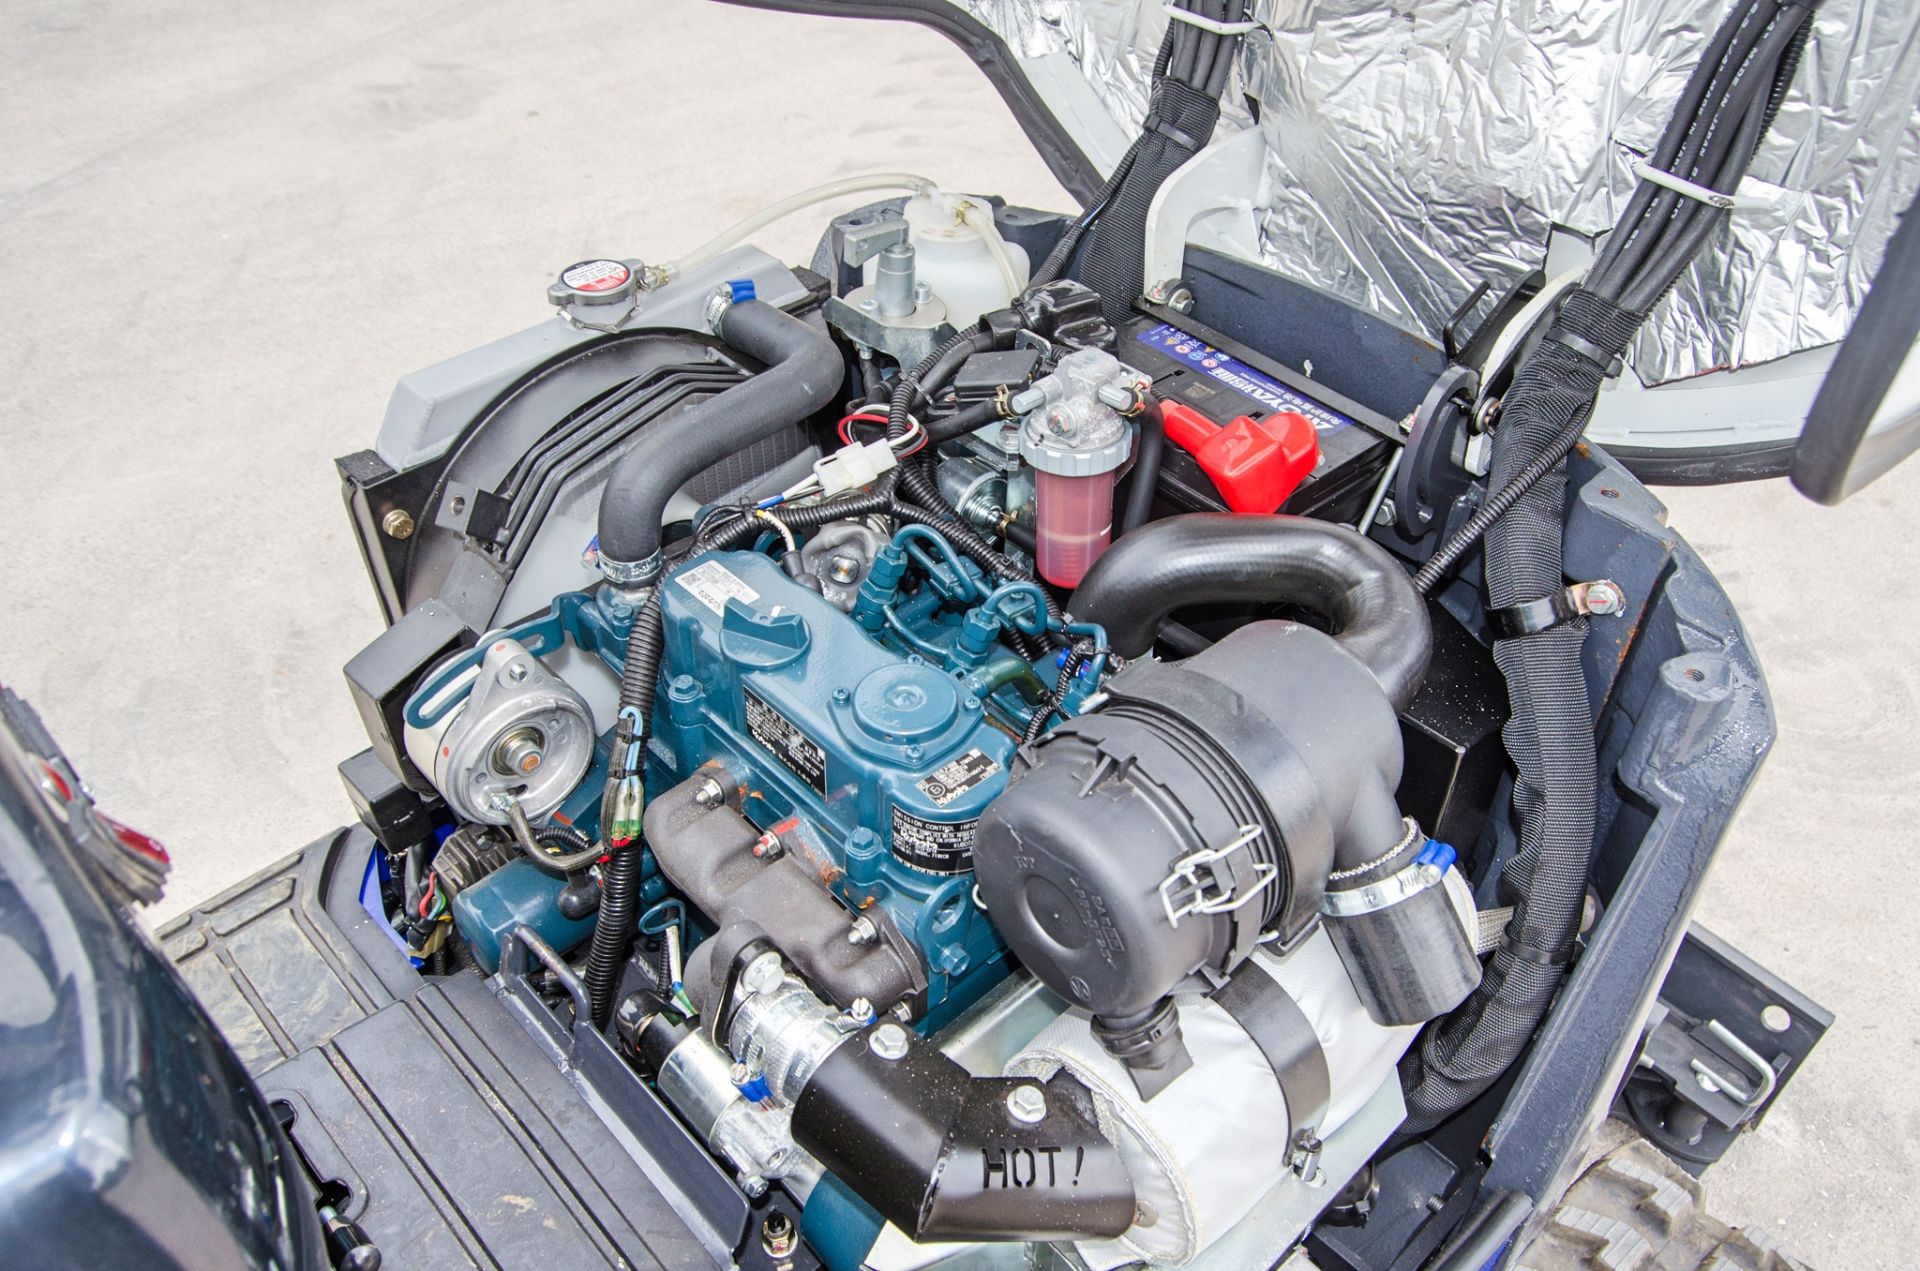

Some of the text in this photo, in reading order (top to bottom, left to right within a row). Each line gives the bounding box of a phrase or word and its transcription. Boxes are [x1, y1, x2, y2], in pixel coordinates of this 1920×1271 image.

[1731, 47, 1758, 87] MADE
[1698, 79, 1717, 115] MADE
[1721, 93, 1731, 108] IN
[1688, 122, 1697, 135] IN
[1699, 113, 1719, 157] JAPAN
[1669, 142, 1687, 173] JAPA
[893, 808, 923, 828] EMISSION
[925, 823, 955, 832] CONTROL
[981, 1145, 1085, 1189] HOT!
